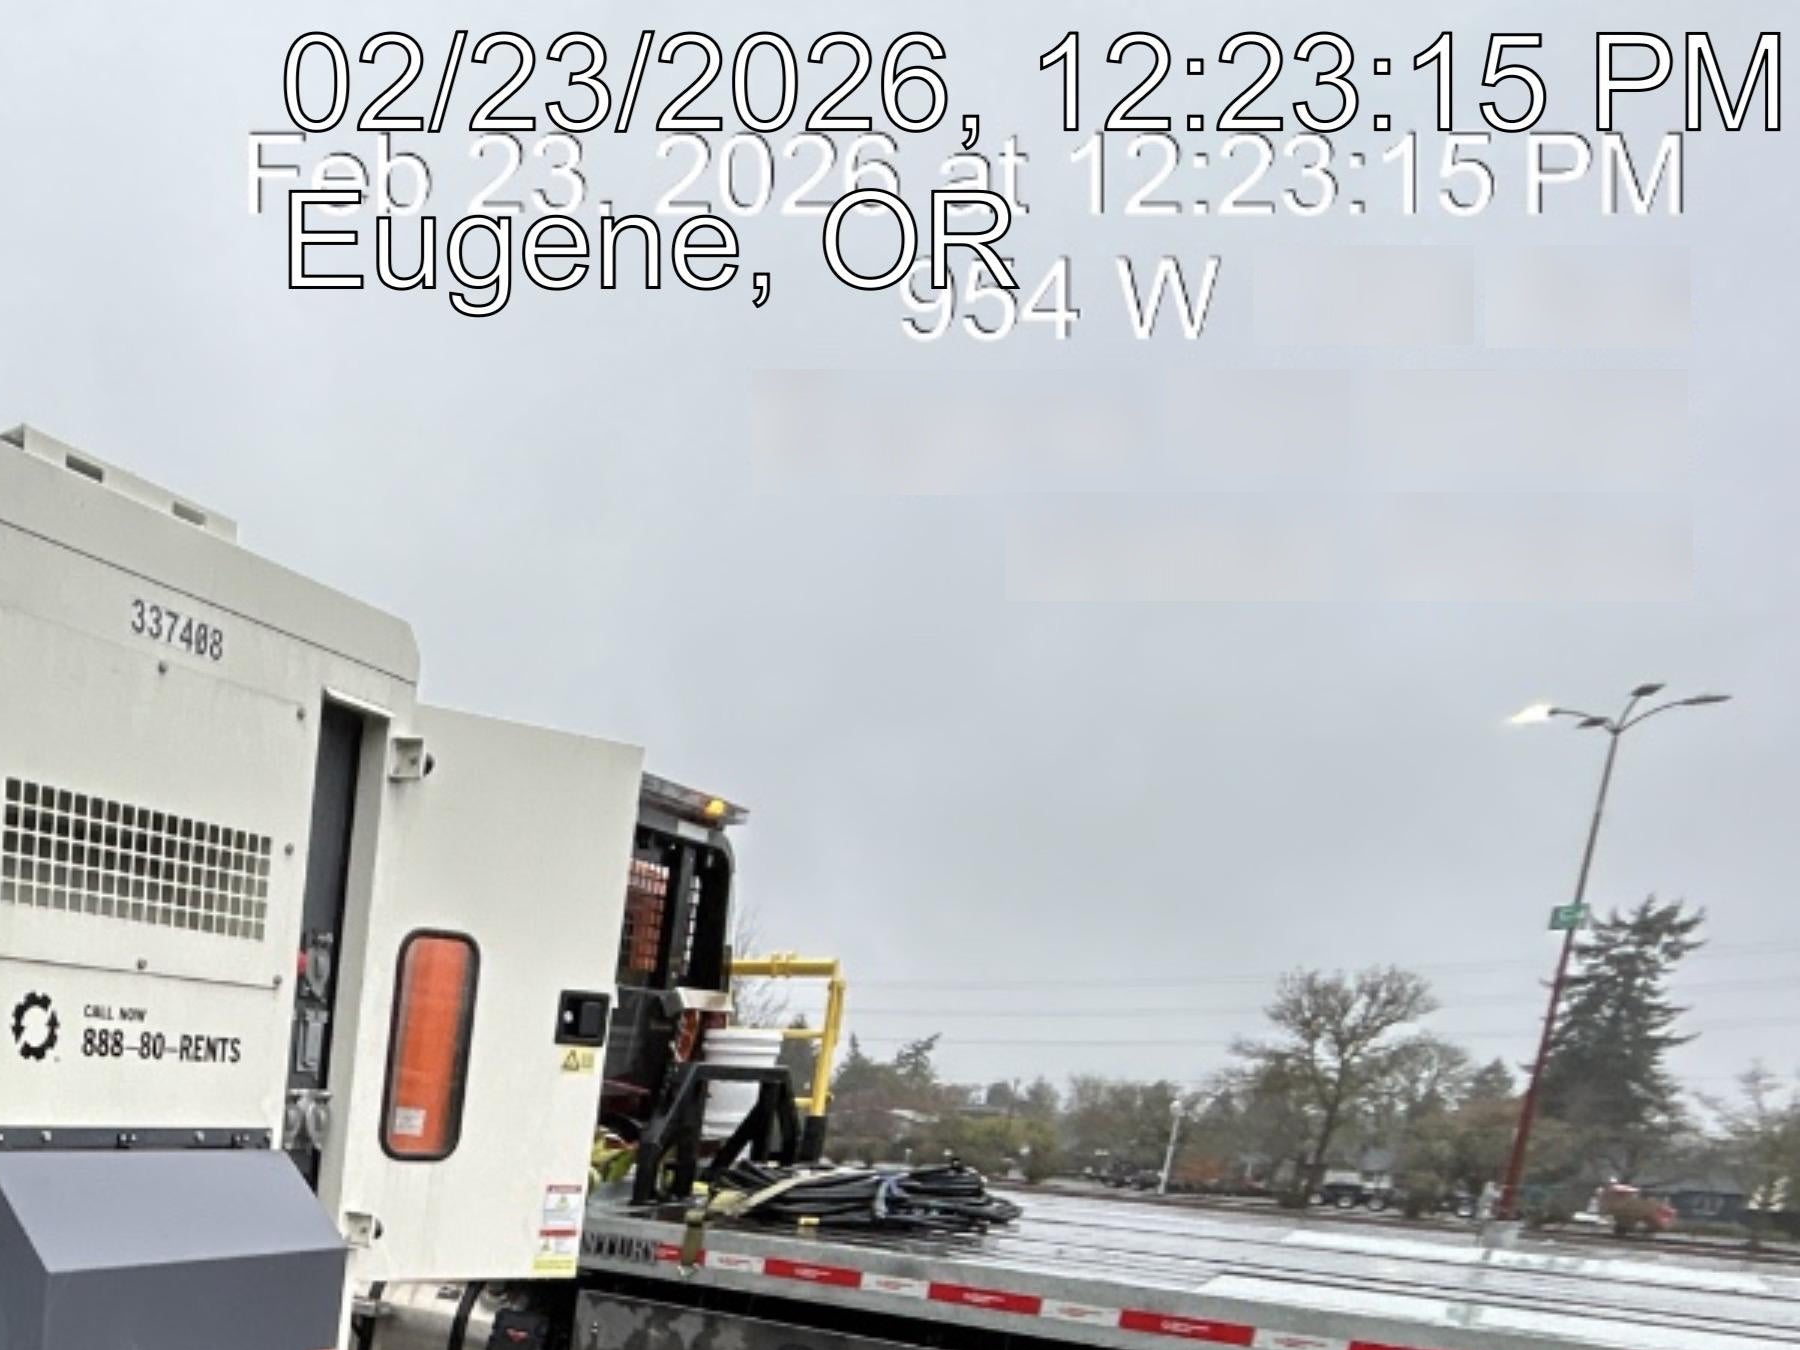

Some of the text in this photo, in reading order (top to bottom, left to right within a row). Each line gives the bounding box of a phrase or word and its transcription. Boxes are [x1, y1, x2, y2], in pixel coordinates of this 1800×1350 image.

[131, 598, 223, 661] 337408
[83, 1004, 147, 1022] CALL NOW
[82, 1027, 242, 1064] 888-80-RENTS
